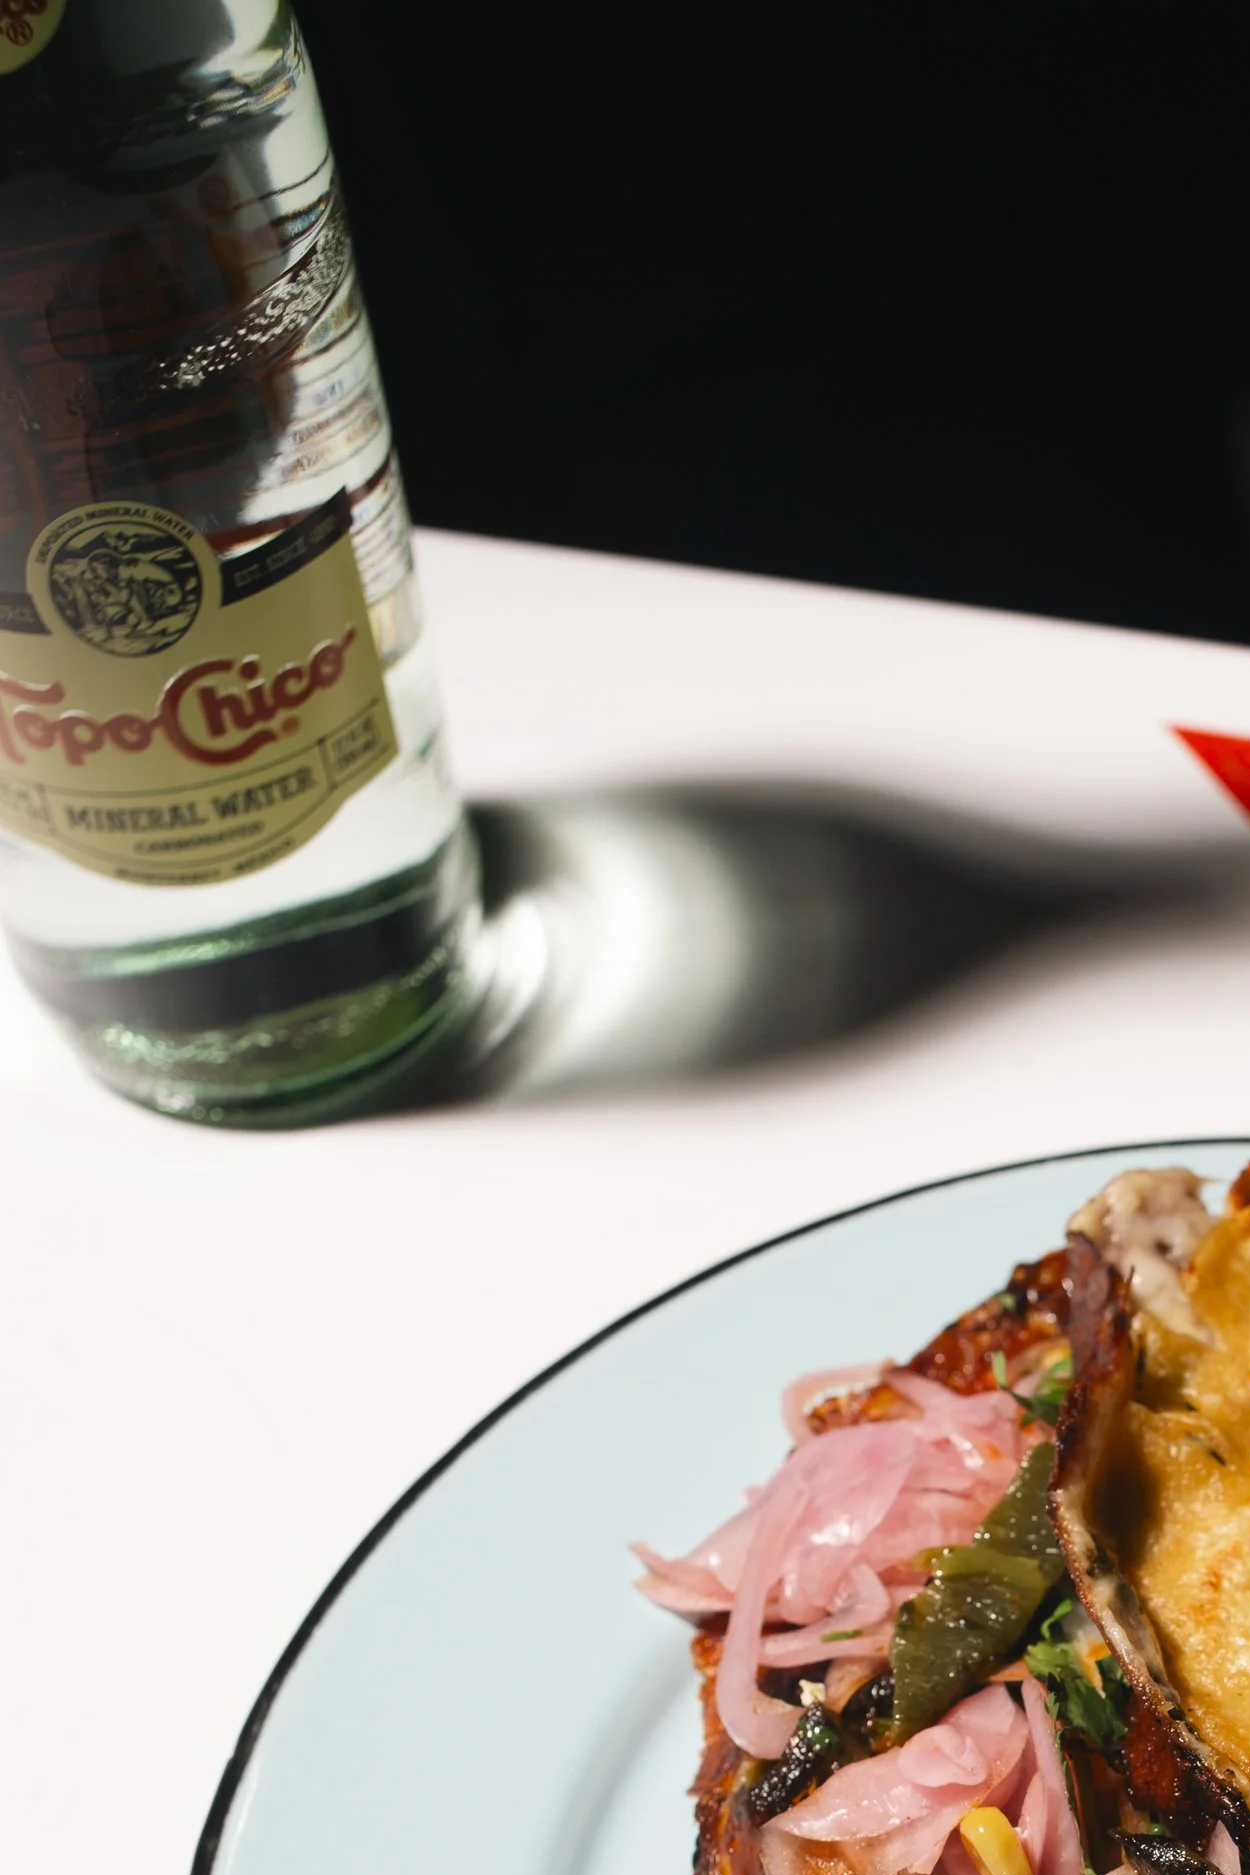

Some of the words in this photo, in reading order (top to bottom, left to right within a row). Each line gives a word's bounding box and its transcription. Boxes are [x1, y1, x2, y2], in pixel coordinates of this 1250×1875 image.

[85, 506, 151, 521] MINERAL
[152, 510, 196, 542] WATER
[156, 627, 357, 767] Chico
[64, 800, 209, 834] MINERAL
[211, 765, 317, 819] WATER
